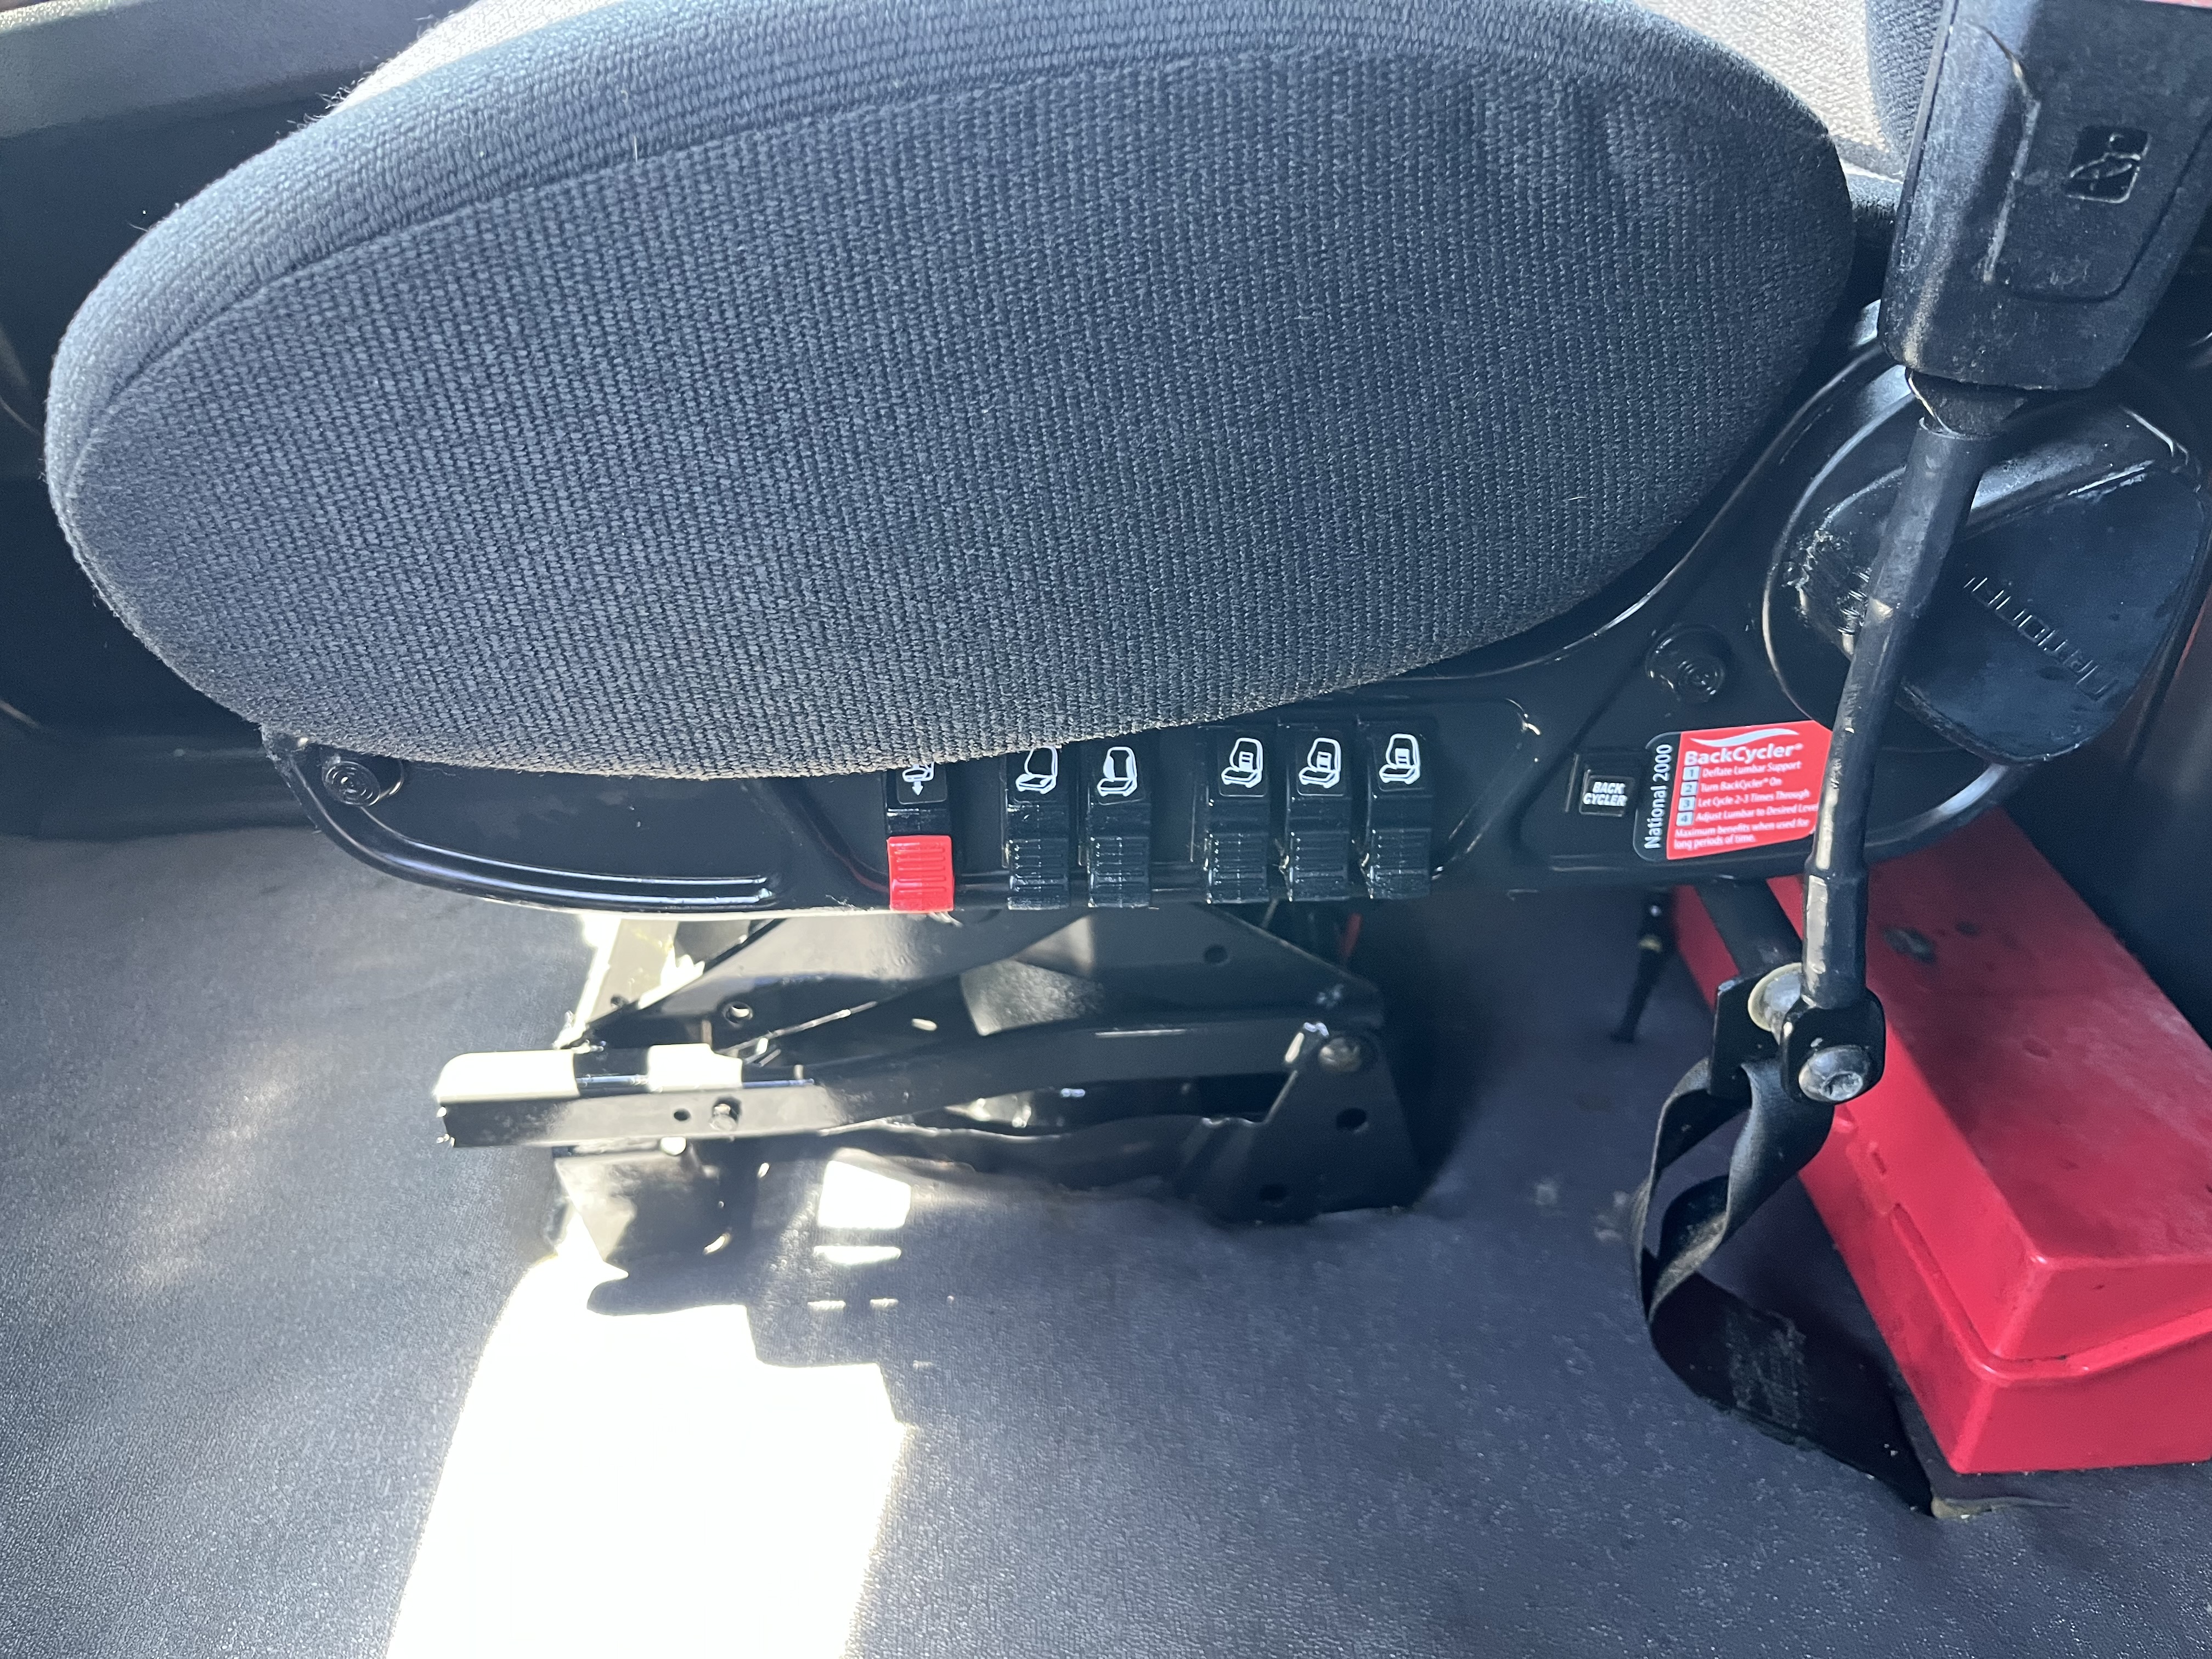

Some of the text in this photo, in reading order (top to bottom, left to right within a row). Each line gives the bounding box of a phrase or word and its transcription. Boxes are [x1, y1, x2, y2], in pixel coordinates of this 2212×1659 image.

[1703, 766, 1731, 778] Deflate
[1734, 764, 1765, 775] Lumbar
[1768, 761, 1802, 773] Support
[1593, 781, 1626, 794] BACK
[1701, 782, 1718, 792] Turn
[1769, 777, 1781, 786] On
[1583, 793, 1628, 806] CYCLER
[1644, 744, 1673, 849] National 2000
[1698, 798, 1711, 808] Let
[1713, 796, 1733, 807] Cycle
[1735, 795, 1748, 804] 2-3
[1751, 793, 1774, 802] Times
[1776, 789, 1809, 800] Through
[1695, 812, 1722, 822] Adjust
[1724, 809, 1754, 819] Lumbar
[1767, 804, 1796, 815] Desired
[1675, 818, 1809, 838] Maximum benefits when used for
[1674, 833, 1756, 850] long periods of time.
